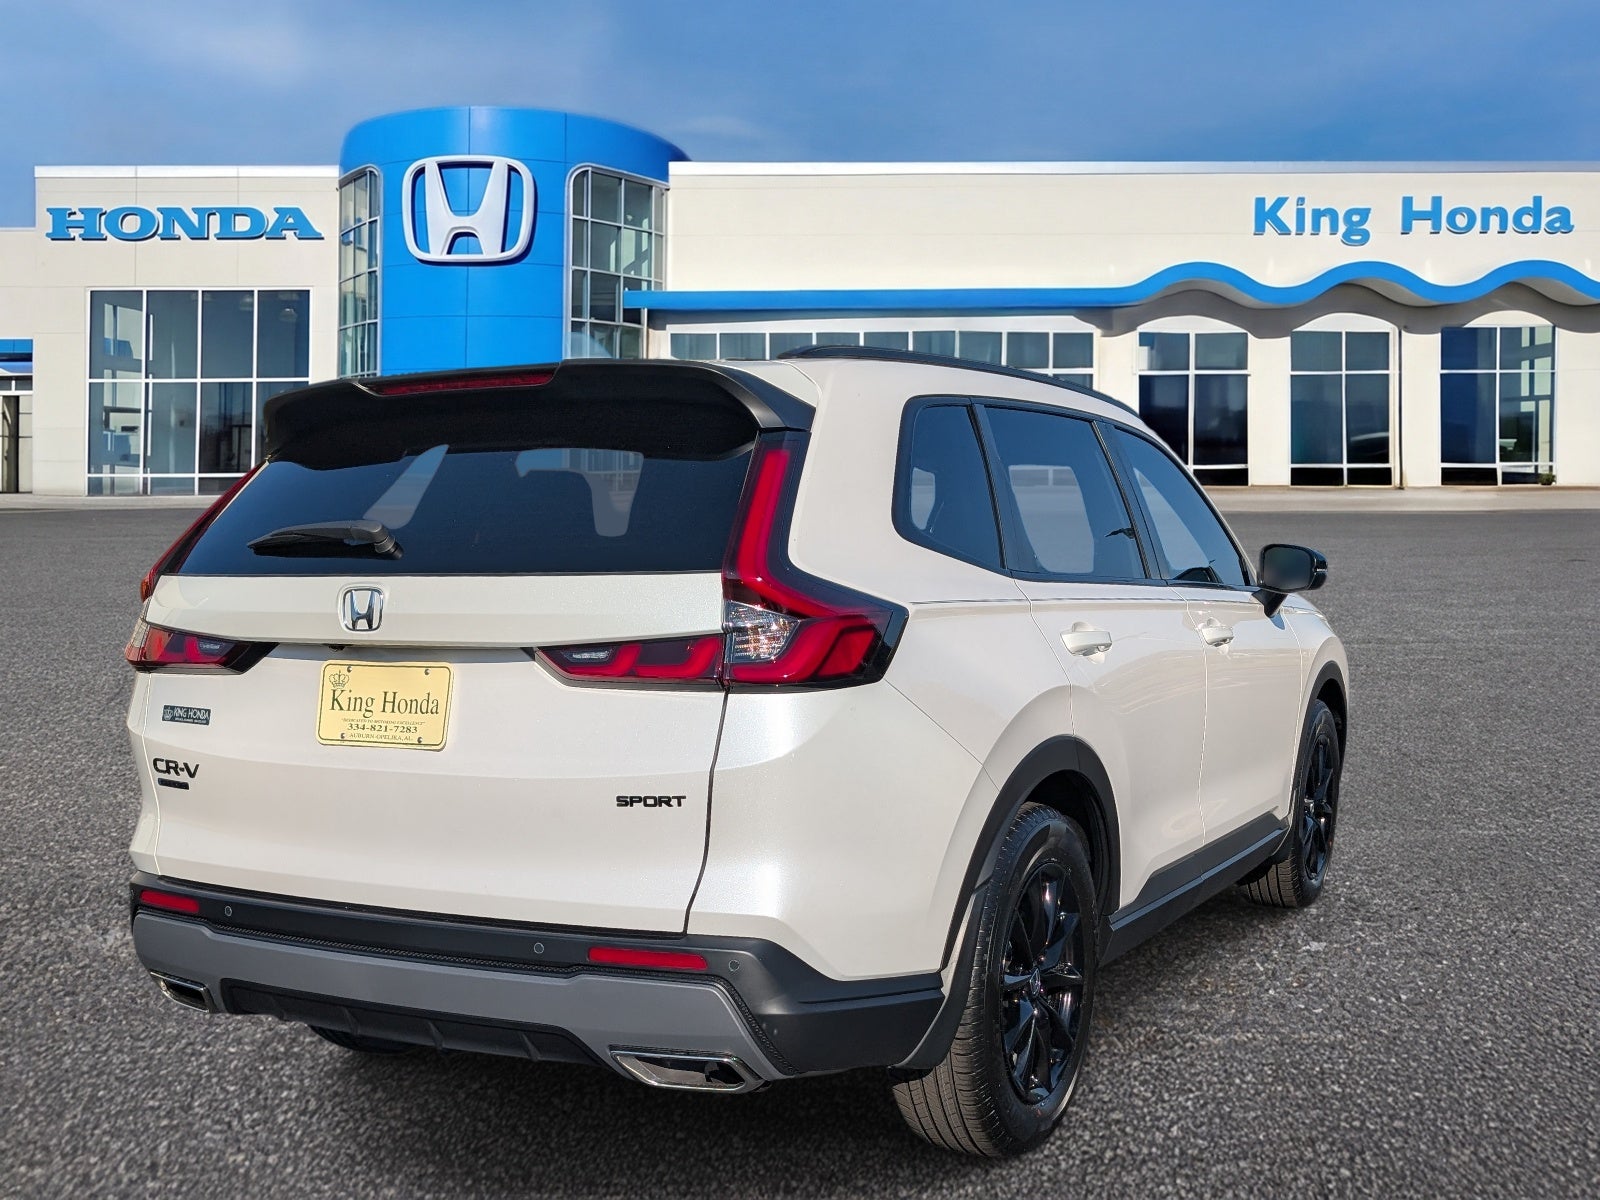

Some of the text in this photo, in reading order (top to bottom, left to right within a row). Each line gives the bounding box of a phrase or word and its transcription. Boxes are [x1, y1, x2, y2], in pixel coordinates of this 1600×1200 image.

[45, 206, 325, 241] HONDA
[1253, 195, 1575, 246] King Honda
[329, 688, 439, 718] King Honda
[174, 707, 209, 720] KING HONDA
[347, 723, 418, 734] 334-821-7283
[153, 758, 199, 778] CR-V
[616, 795, 687, 807] SPORT
